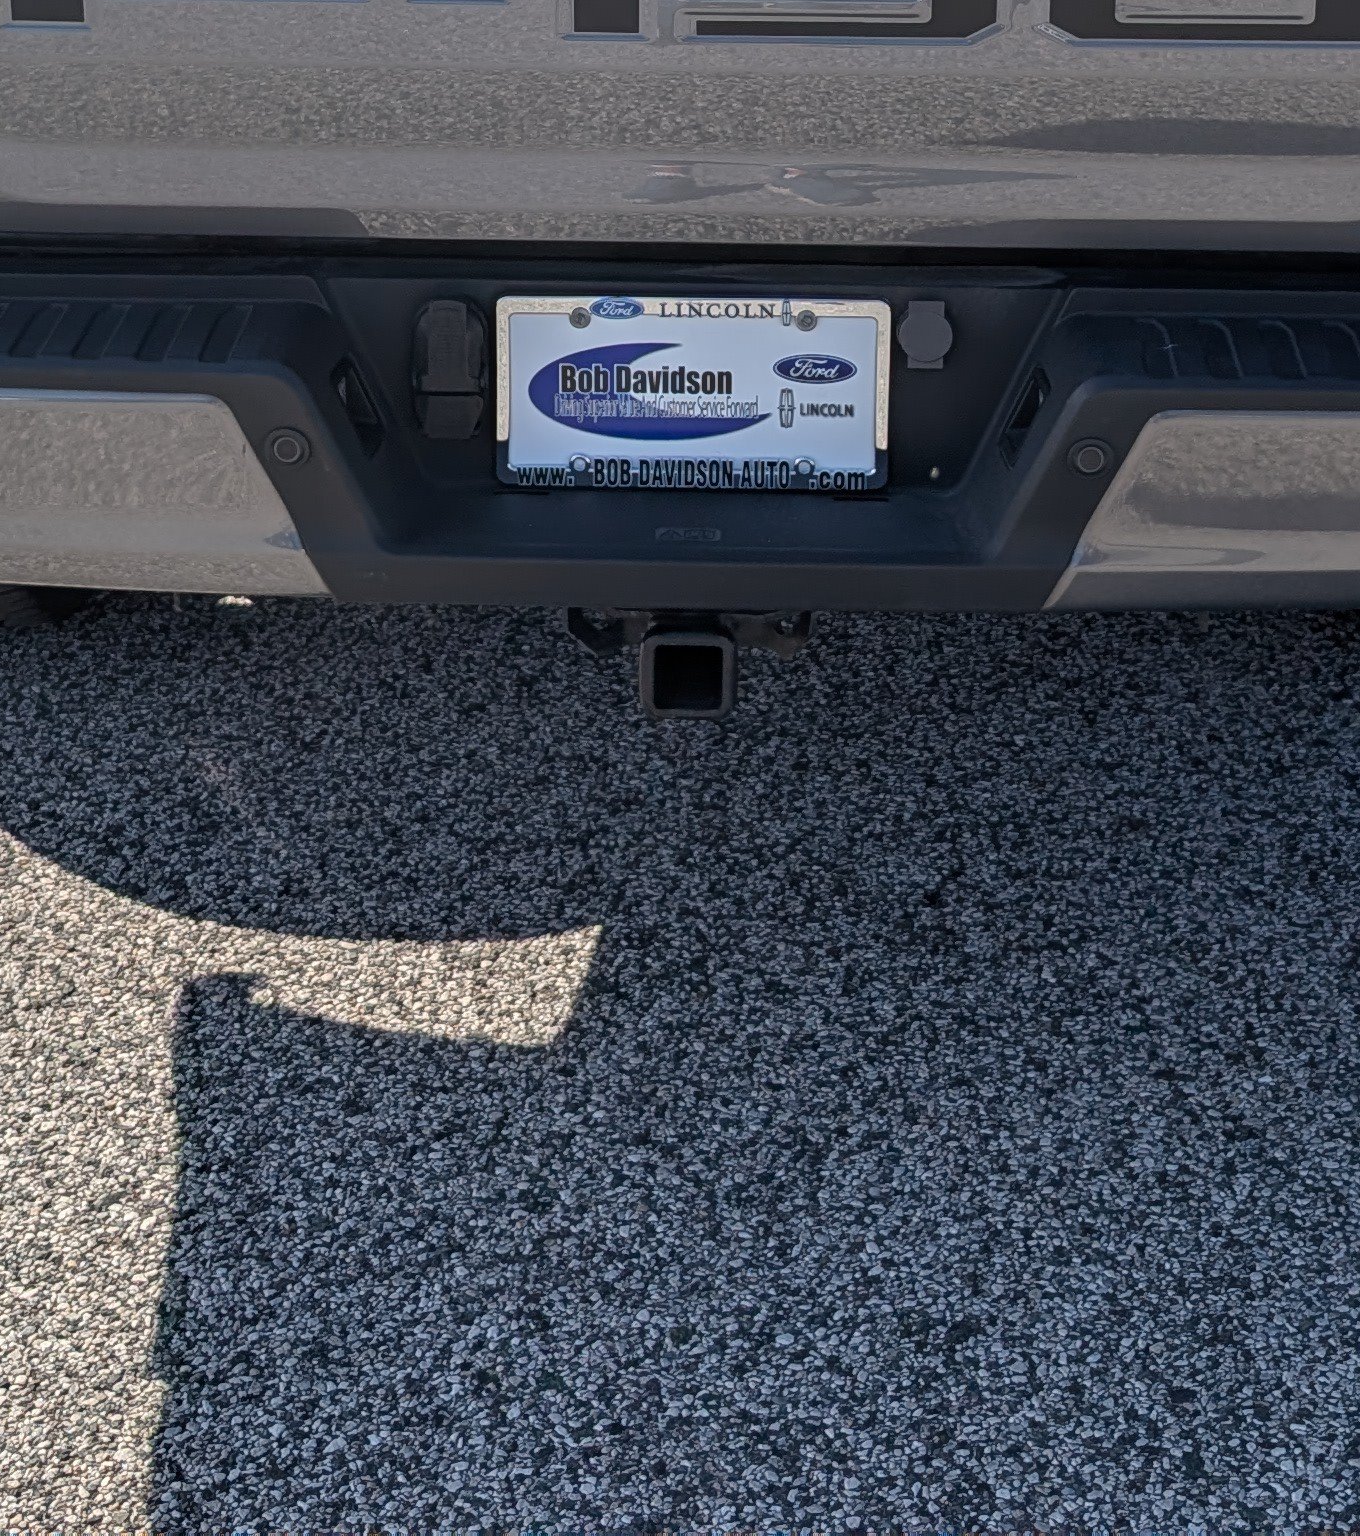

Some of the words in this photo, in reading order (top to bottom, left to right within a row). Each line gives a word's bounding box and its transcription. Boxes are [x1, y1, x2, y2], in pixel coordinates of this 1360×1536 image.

[599, 300, 634, 317] Ford
[659, 302, 777, 319] LINCOLN
[789, 358, 840, 378] Ford
[560, 364, 610, 394] Bob
[615, 365, 733, 395] Davidson
[659, 395, 696, 417] Customer
[698, 395, 725, 417] Service
[726, 395, 759, 418] Forward
[799, 402, 855, 418] LINCOLN
[593, 457, 632, 488] BOB
[639, 458, 734, 489] DAVIDSON
[740, 459, 791, 489] AUTO
[808, 470, 866, 491] .com
